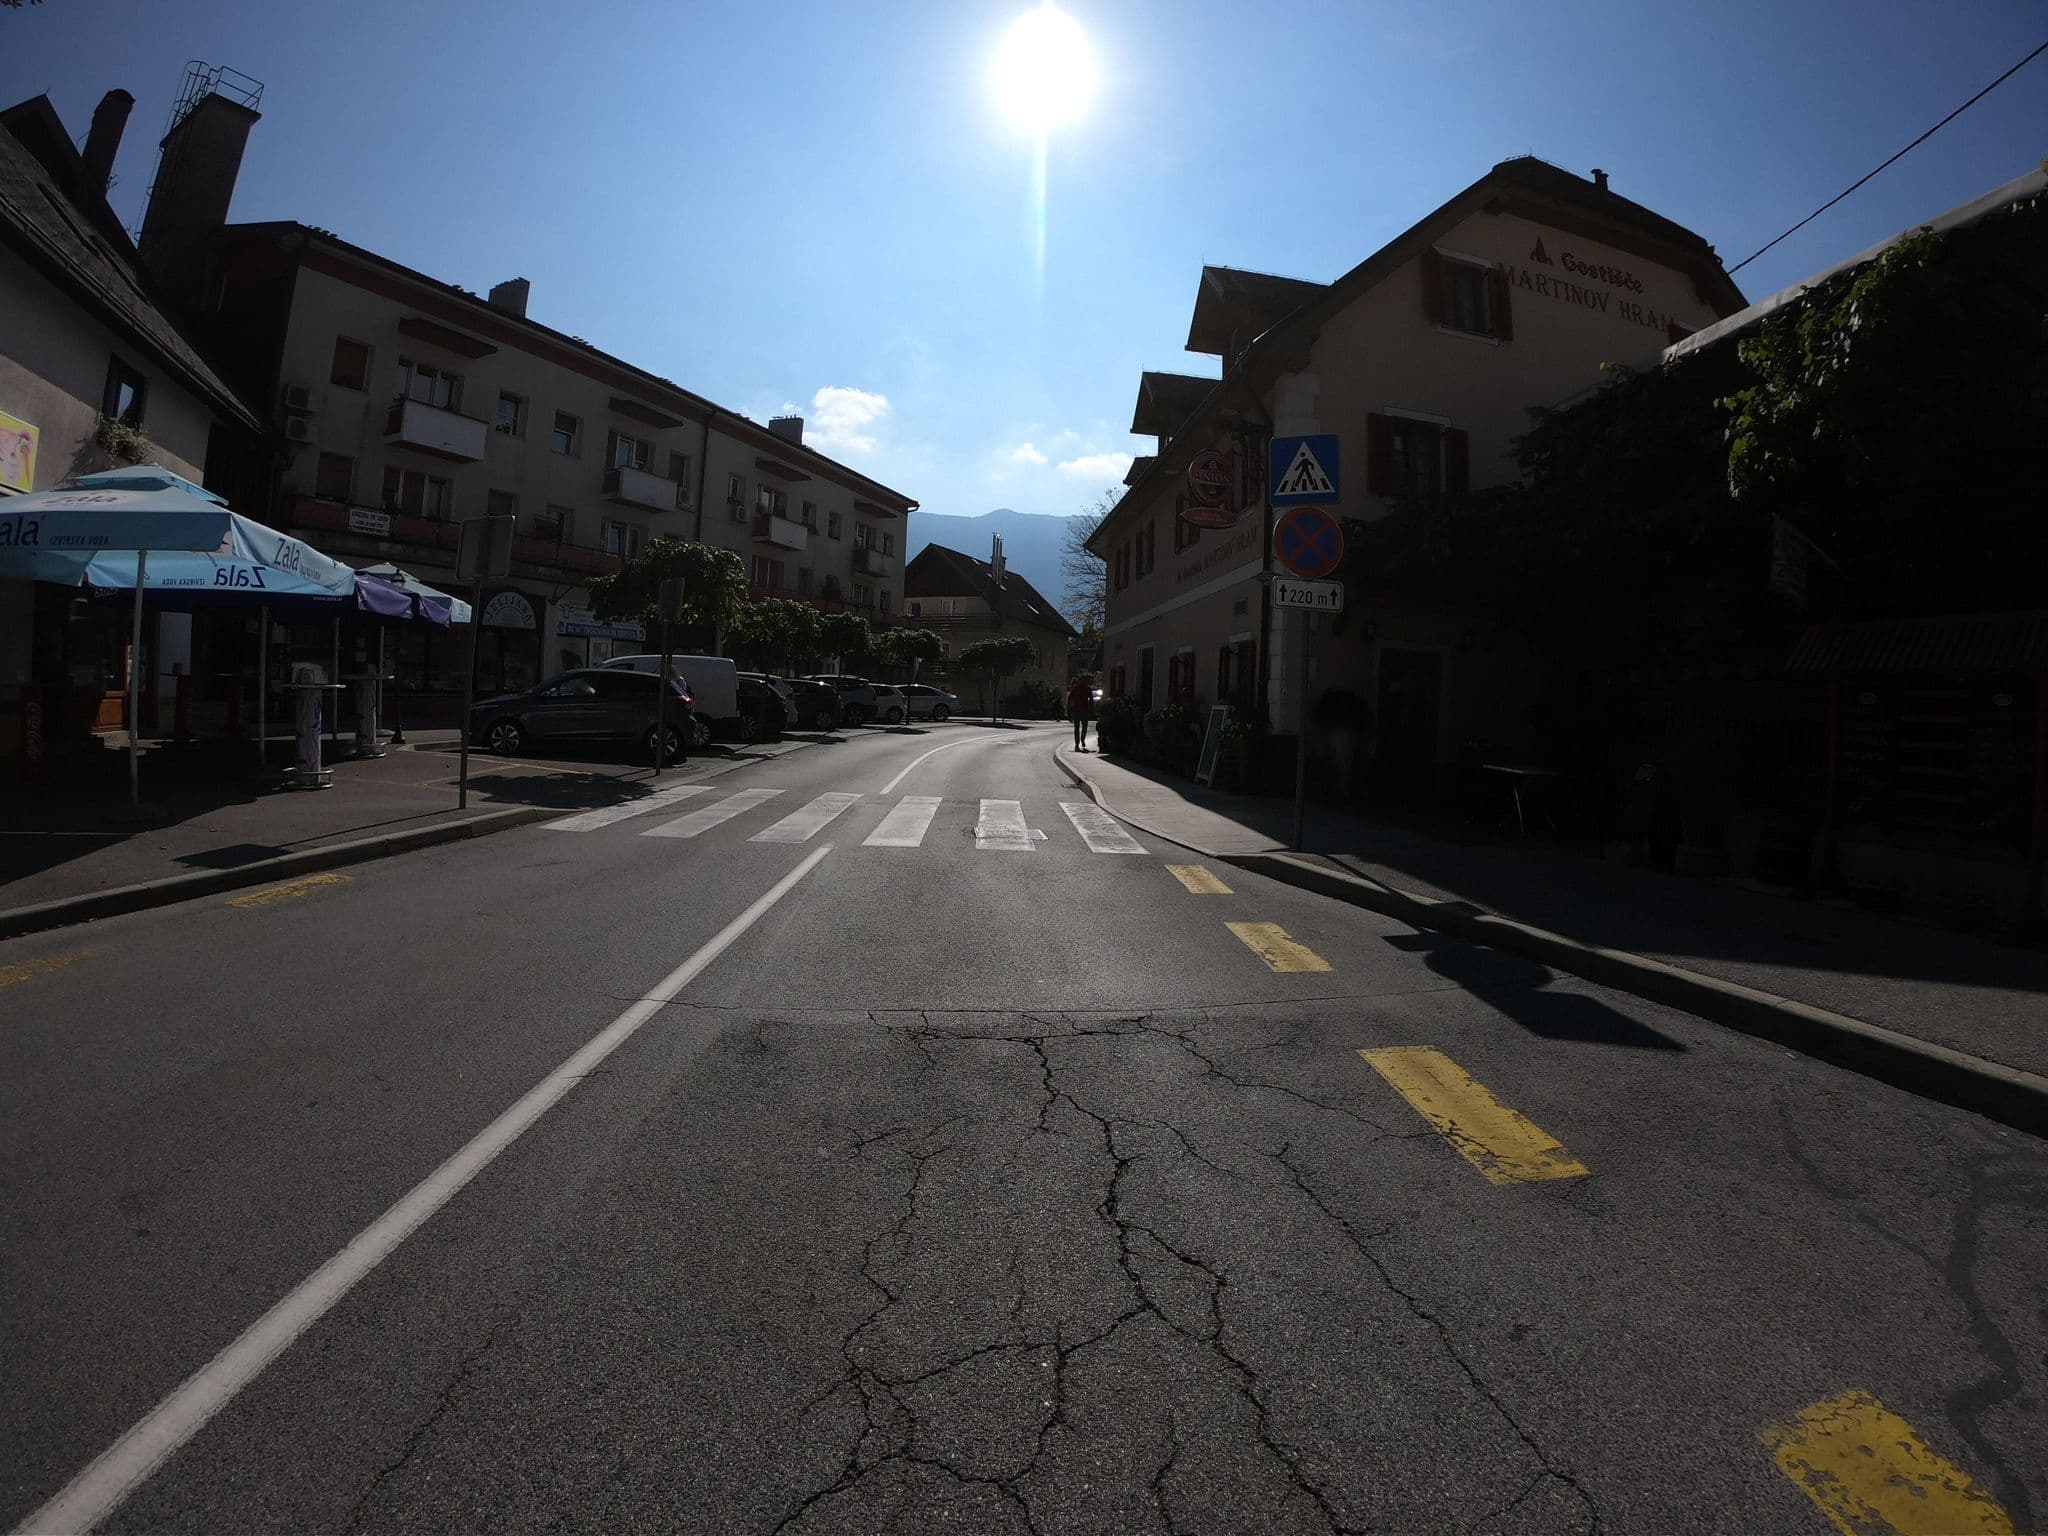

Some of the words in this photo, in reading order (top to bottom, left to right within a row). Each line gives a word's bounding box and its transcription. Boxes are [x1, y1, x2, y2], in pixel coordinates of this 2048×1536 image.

[0, 515, 40, 547] ala
[272, 537, 301, 572] Zala
[1290, 589, 1313, 604] 220
[1318, 595, 1328, 605] m
